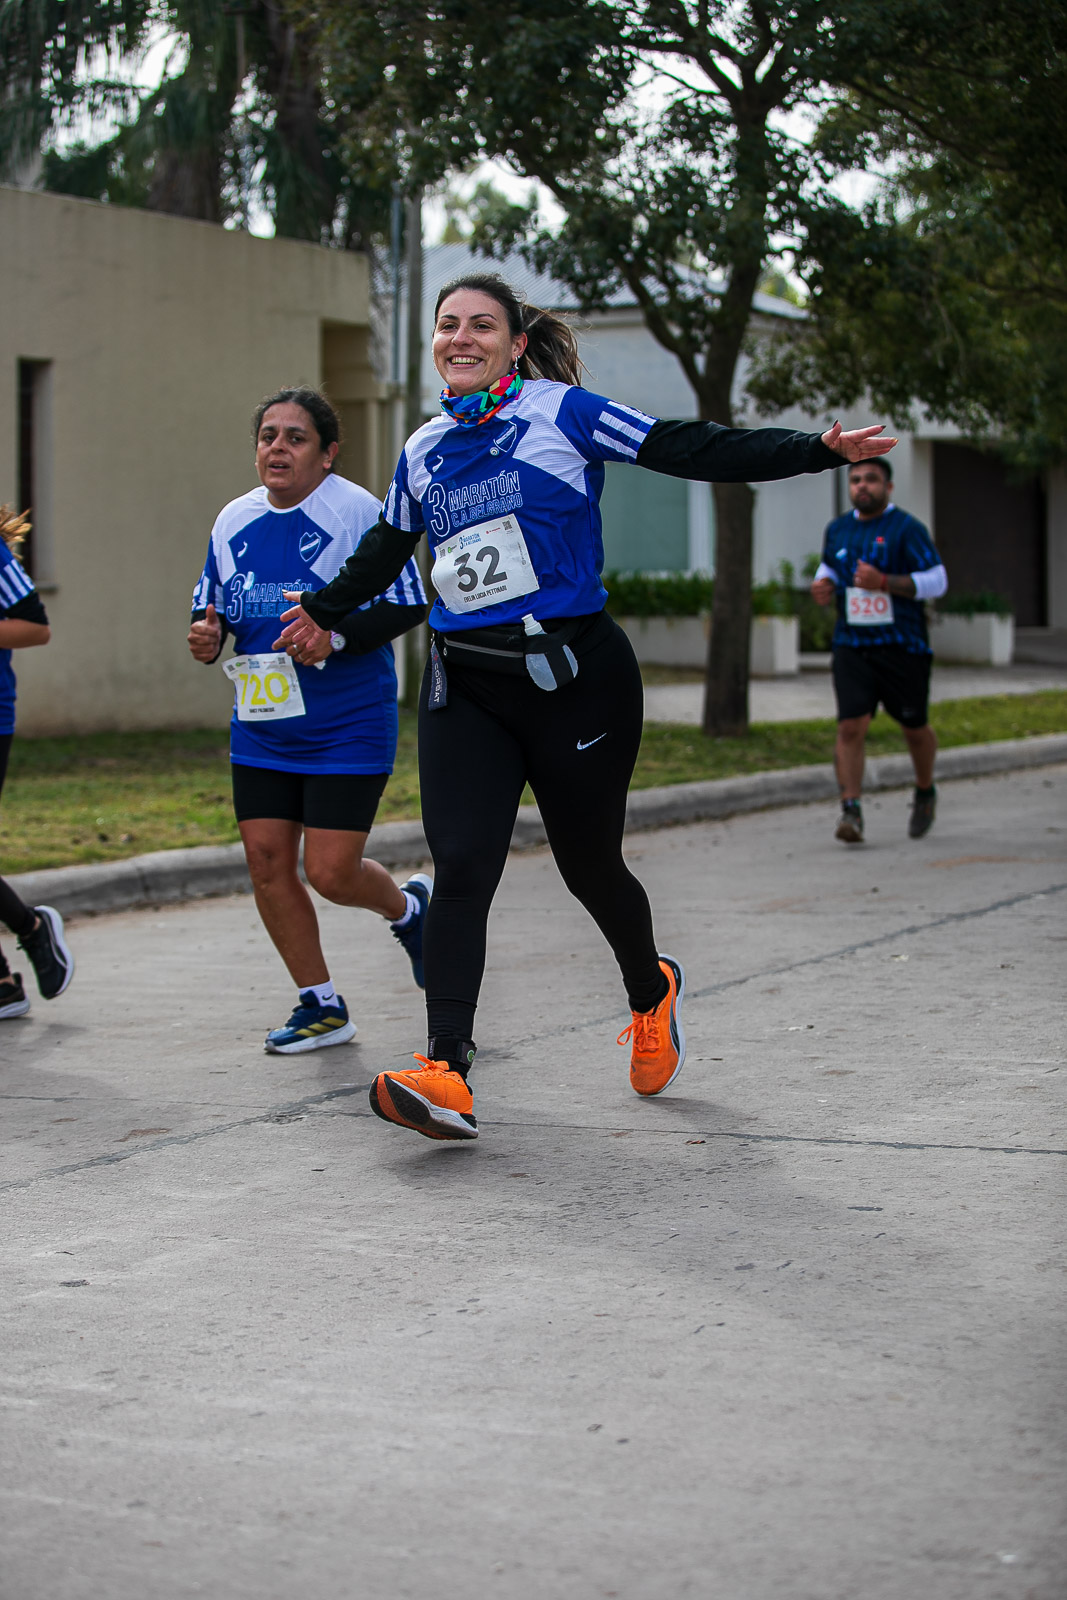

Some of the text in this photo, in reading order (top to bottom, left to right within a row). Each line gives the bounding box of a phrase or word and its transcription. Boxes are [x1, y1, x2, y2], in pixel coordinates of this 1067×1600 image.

[428, 469, 520, 537] 3 MARATÓN
[451, 492, 524, 528] C.A.BELGRANO
[453, 545, 508, 593] 32
[226, 573, 246, 624] 3
[850, 596, 888, 615] 520
[238, 671, 290, 706] 720
